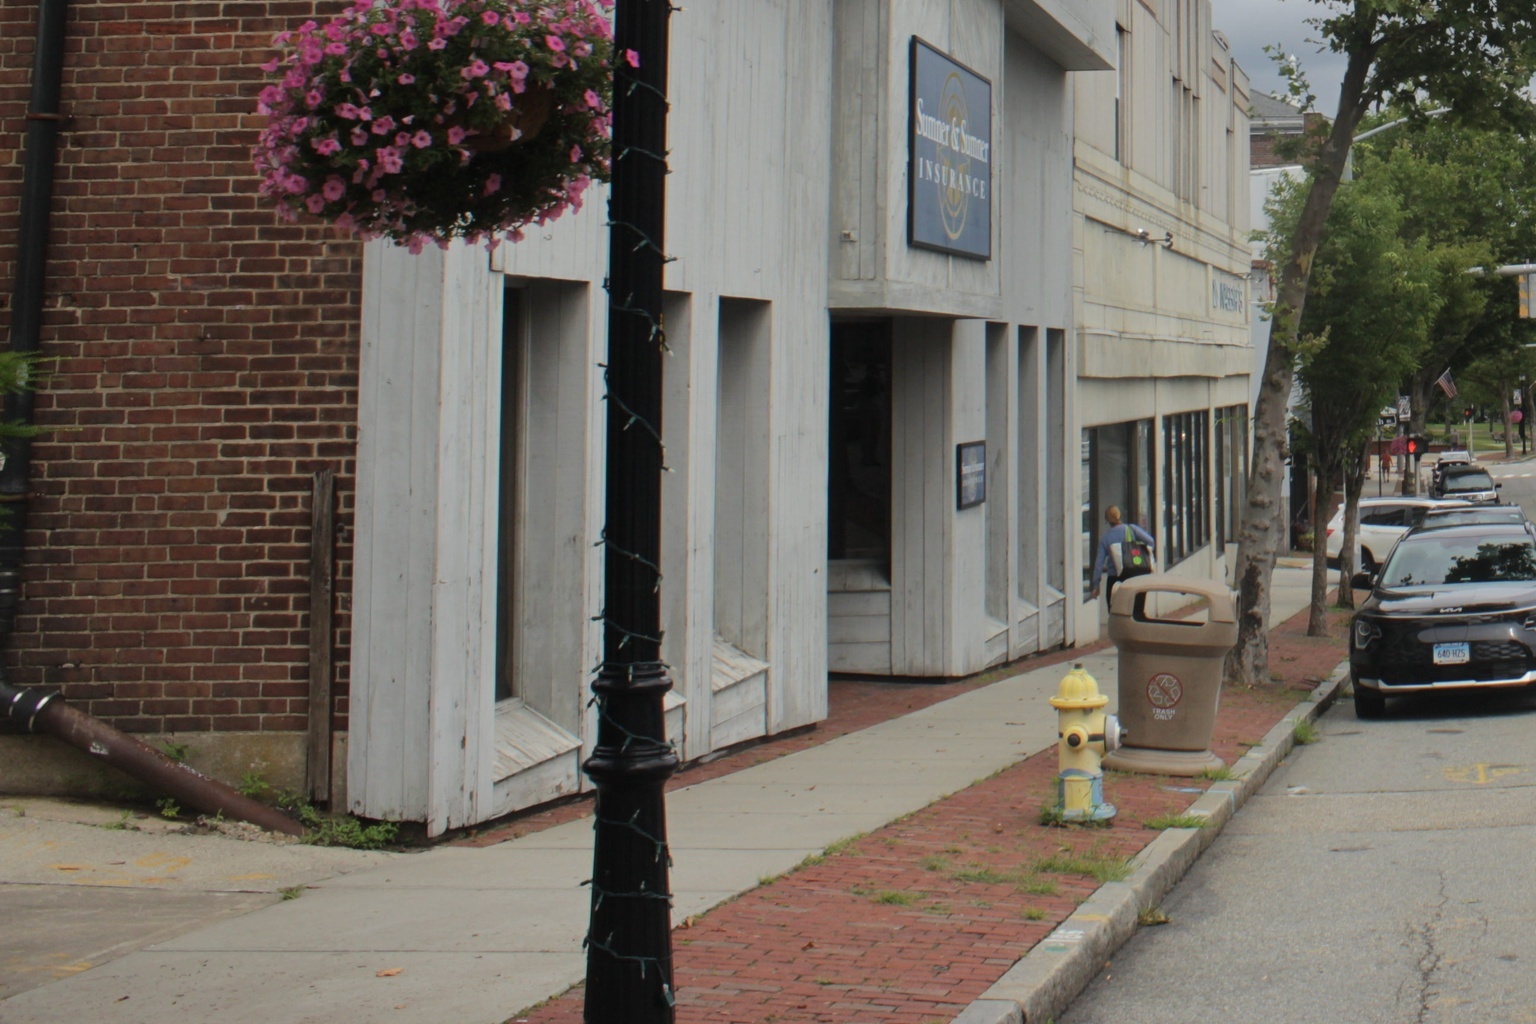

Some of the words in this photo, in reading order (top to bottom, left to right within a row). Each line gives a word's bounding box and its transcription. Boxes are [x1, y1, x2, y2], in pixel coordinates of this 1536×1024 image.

[916, 97, 949, 145] Sumner
[951, 117, 960, 151] &
[960, 119, 989, 163] Sumner
[918, 156, 986, 200] INSURANCE
